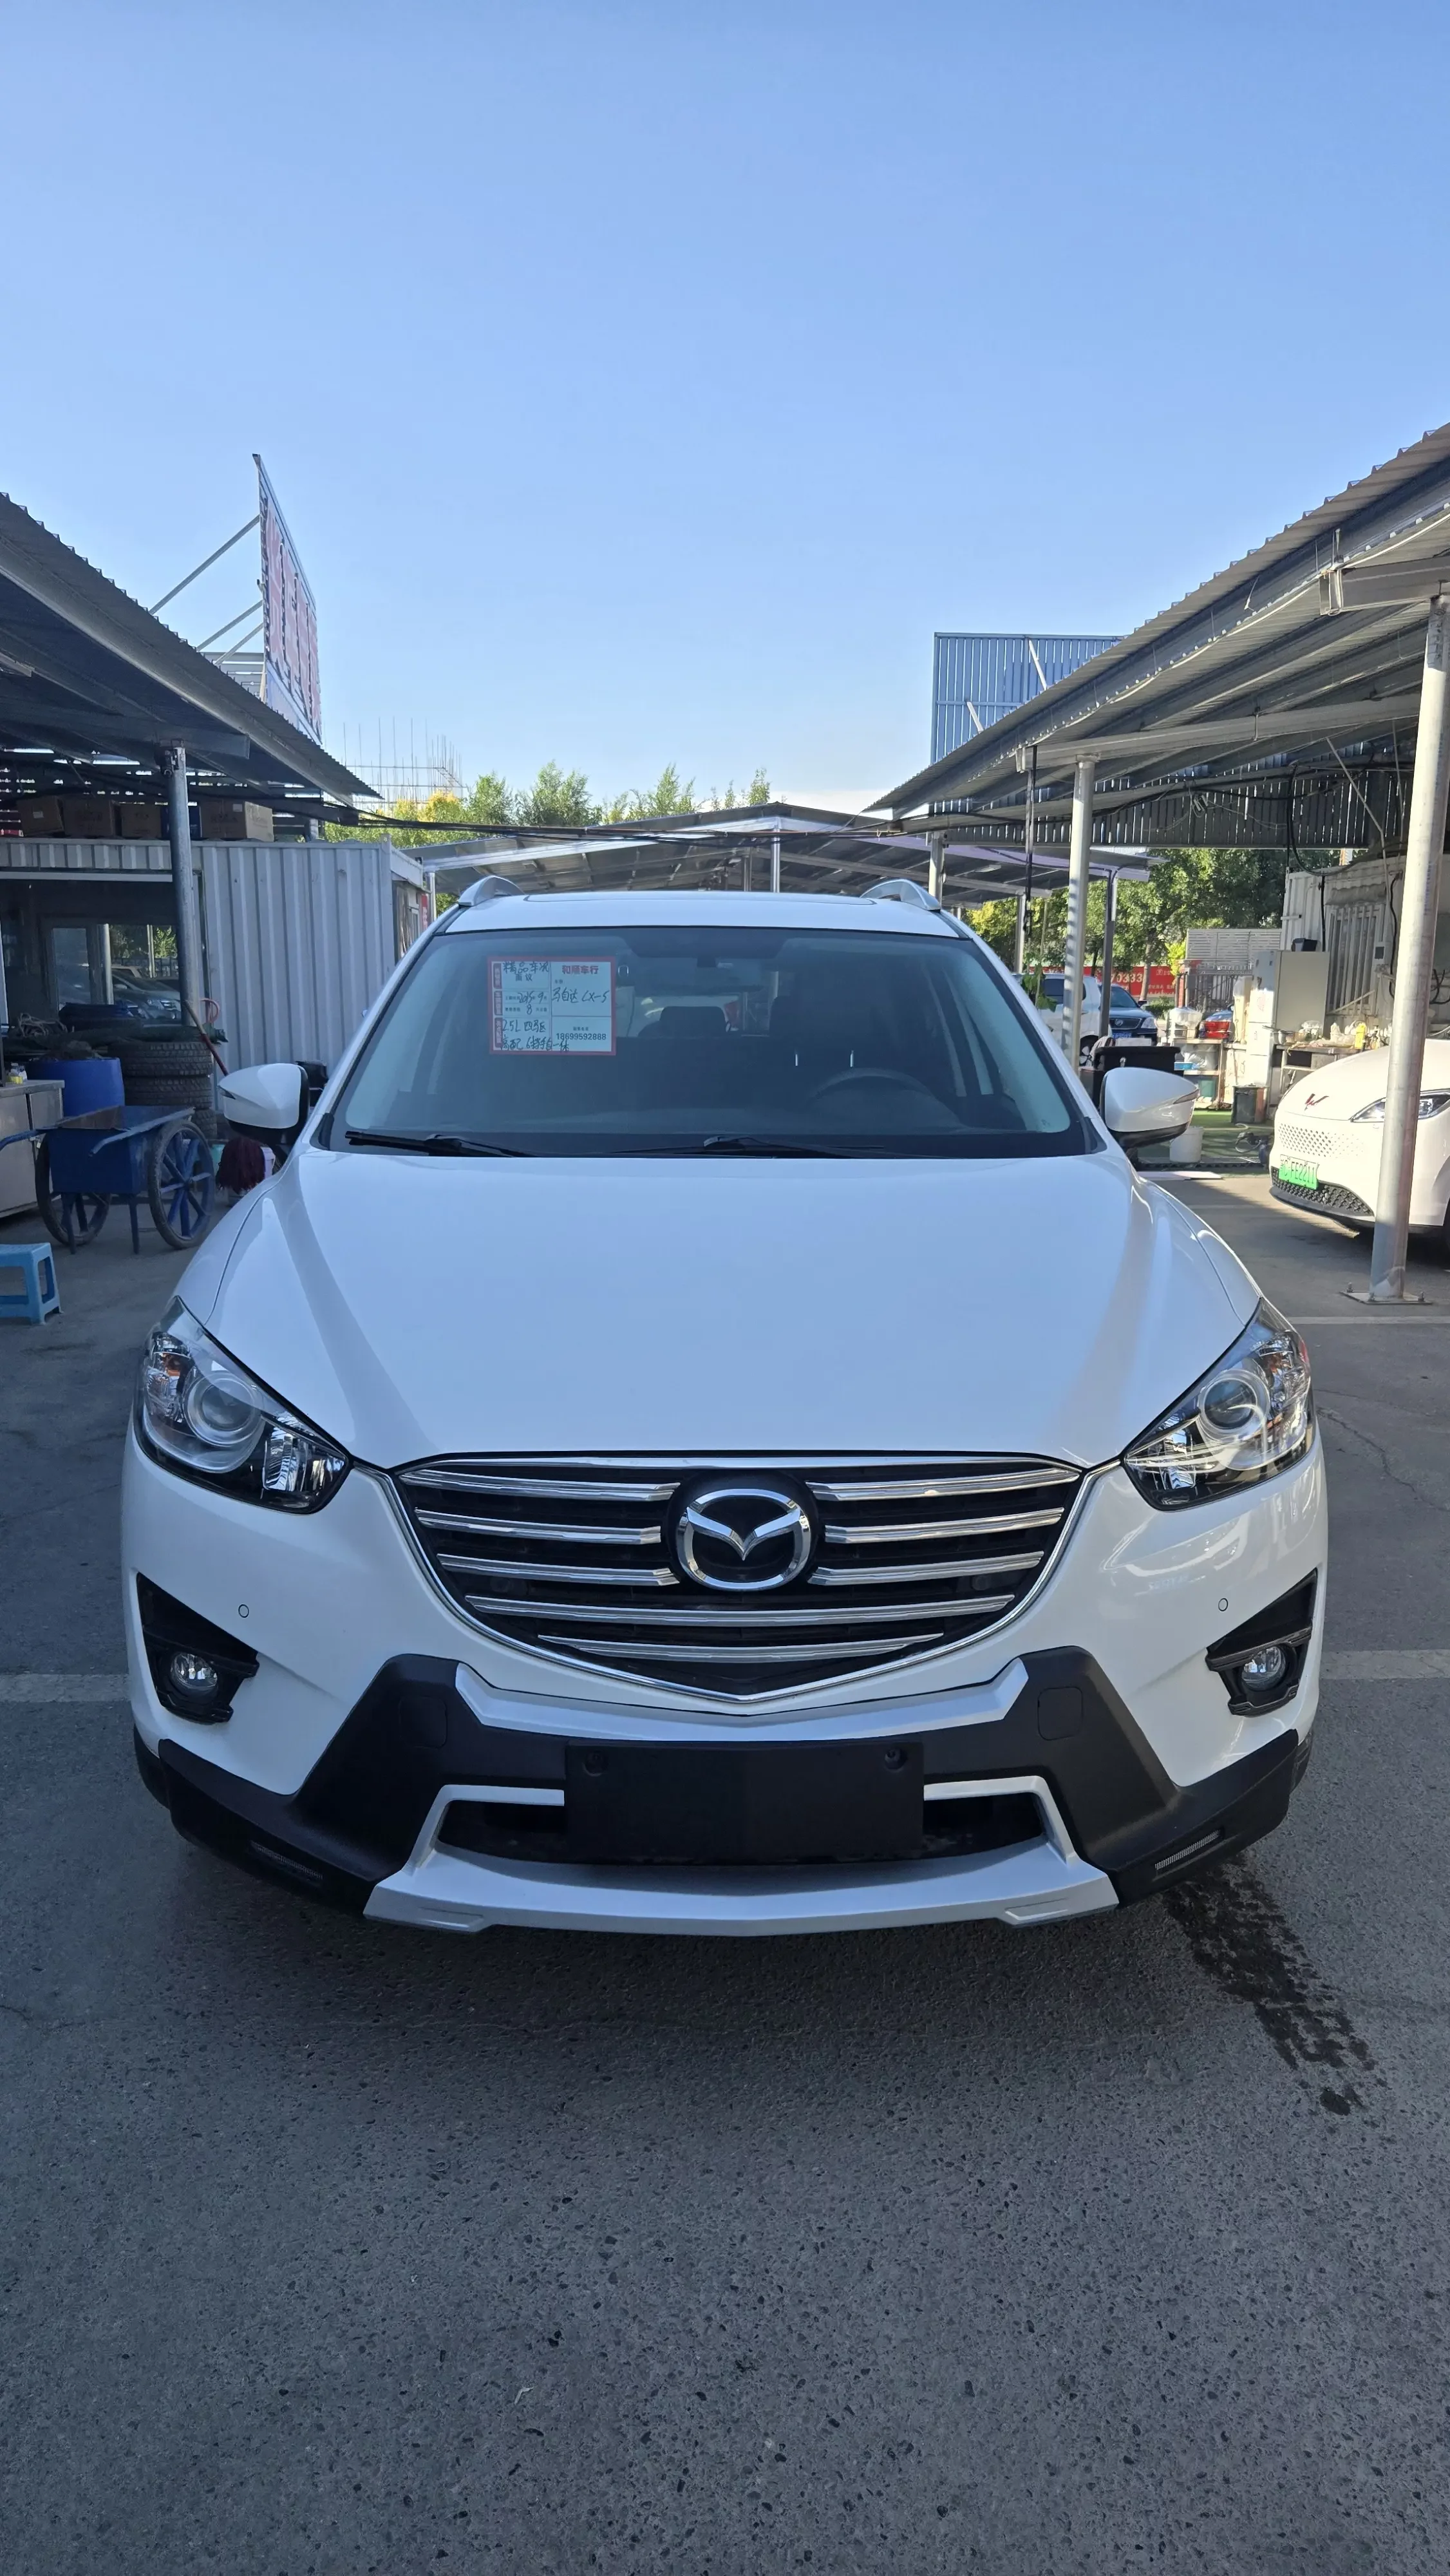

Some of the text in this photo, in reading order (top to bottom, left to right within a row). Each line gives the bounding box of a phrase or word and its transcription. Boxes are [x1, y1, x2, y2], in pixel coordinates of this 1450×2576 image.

[552, 987, 579, 1003] 马自达
[556, 1032, 607, 1041] 18699592888
